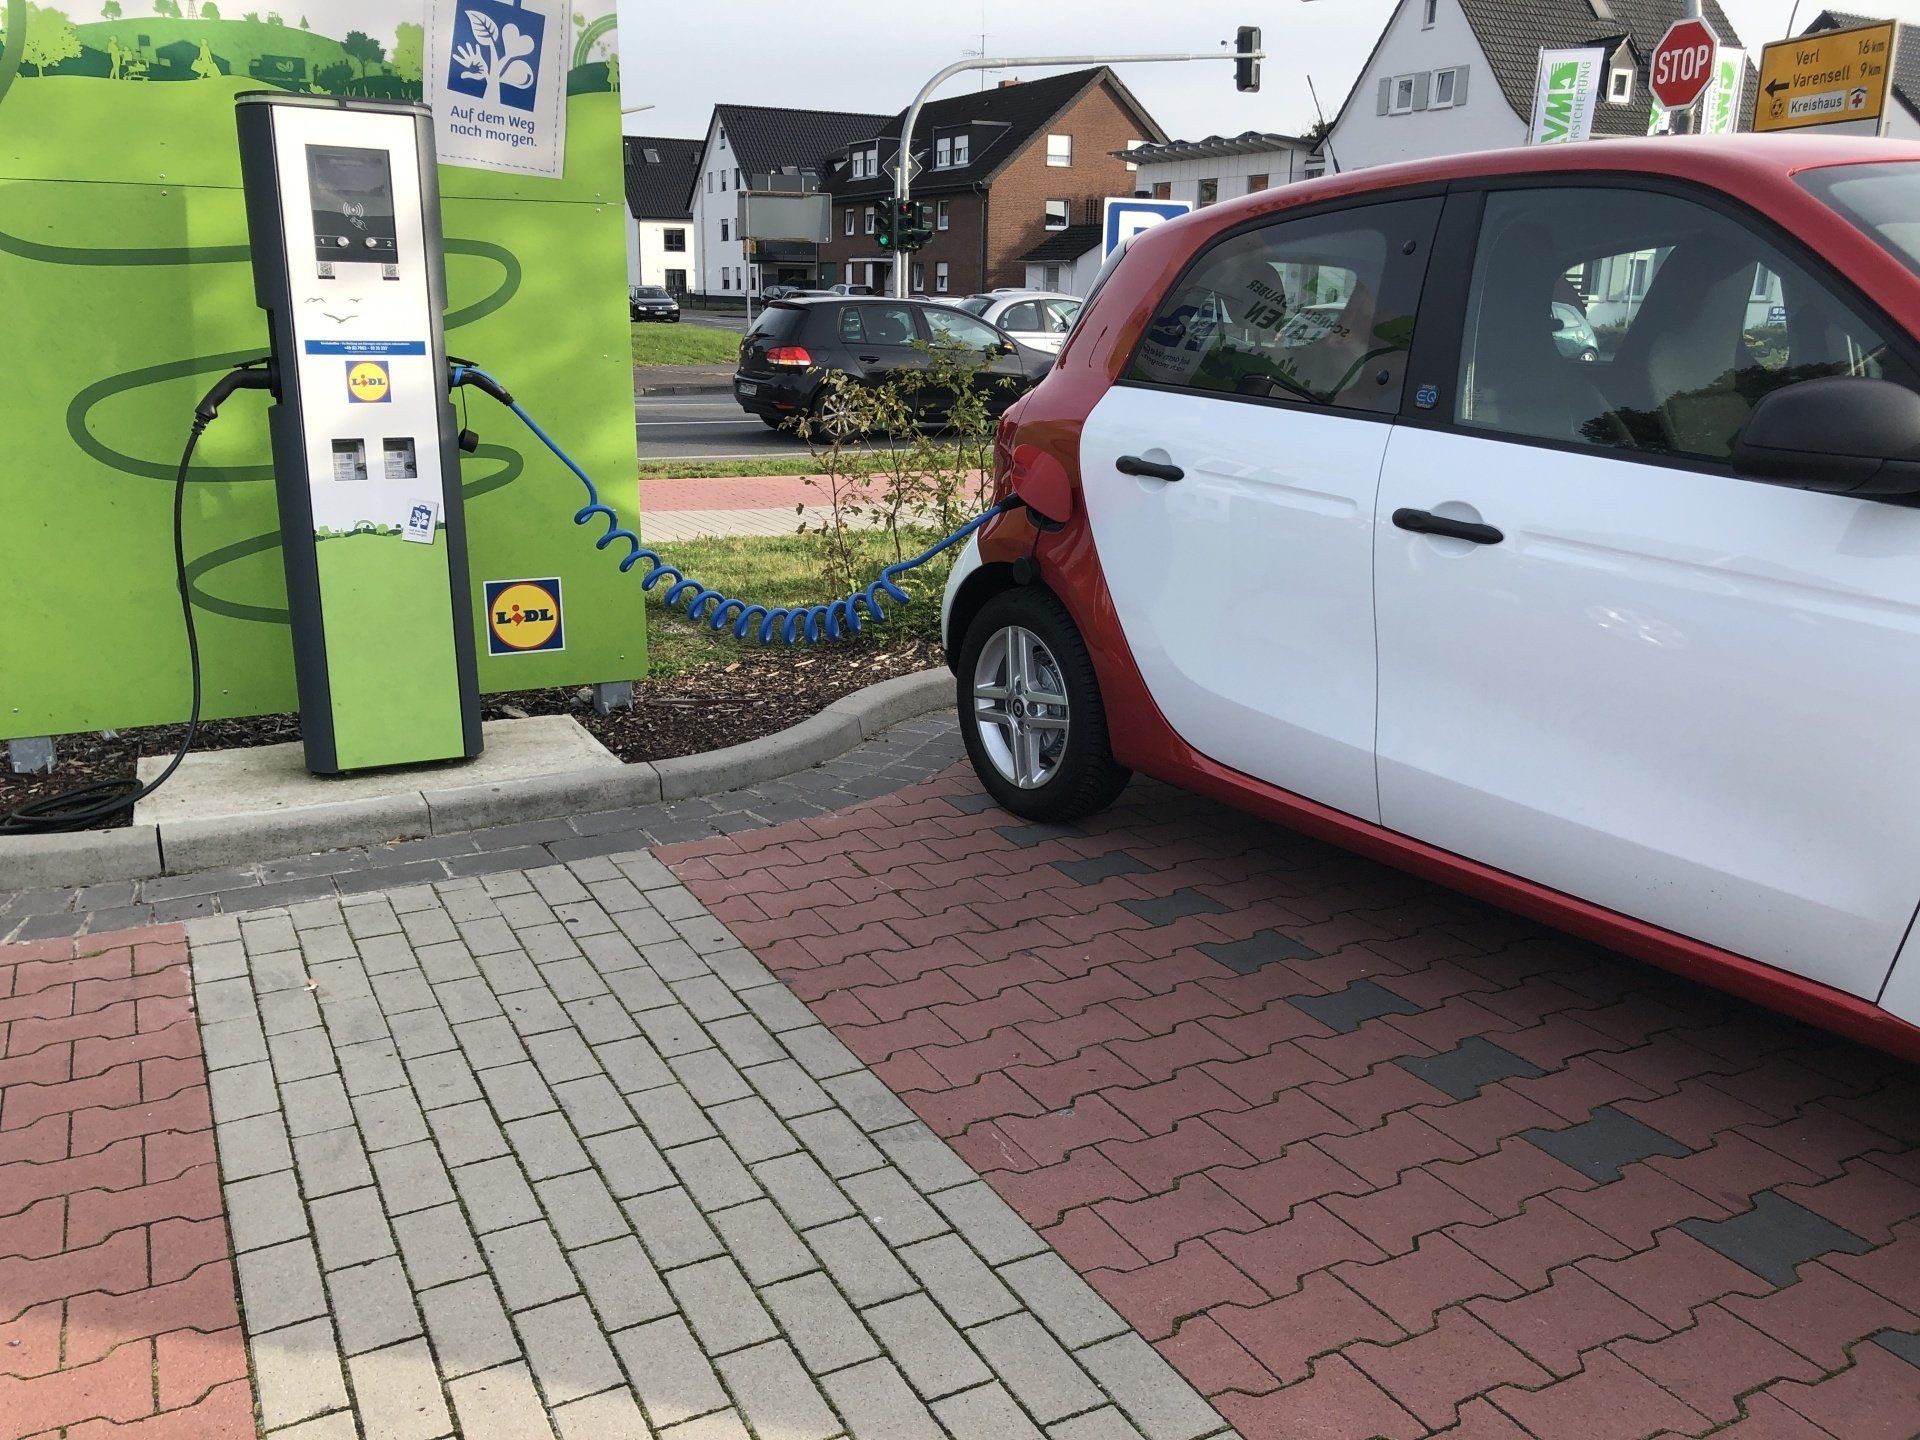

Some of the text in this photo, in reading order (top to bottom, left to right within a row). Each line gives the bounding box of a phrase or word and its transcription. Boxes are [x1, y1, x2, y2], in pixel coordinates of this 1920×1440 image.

[1656, 44, 1709, 85] STOP
[1796, 40, 1884, 66] Verl 16 km
[1793, 62, 1881, 88] Varensell 9 km
[1571, 61, 1592, 140] RSICHERUNG
[1791, 97, 1843, 114] Kreishaus
[450, 105, 535, 135] Auf dem Weg
[1540, 94, 1574, 144] VM
[450, 123, 538, 148] nach morgen.
[1416, 389, 1437, 403] EQ
